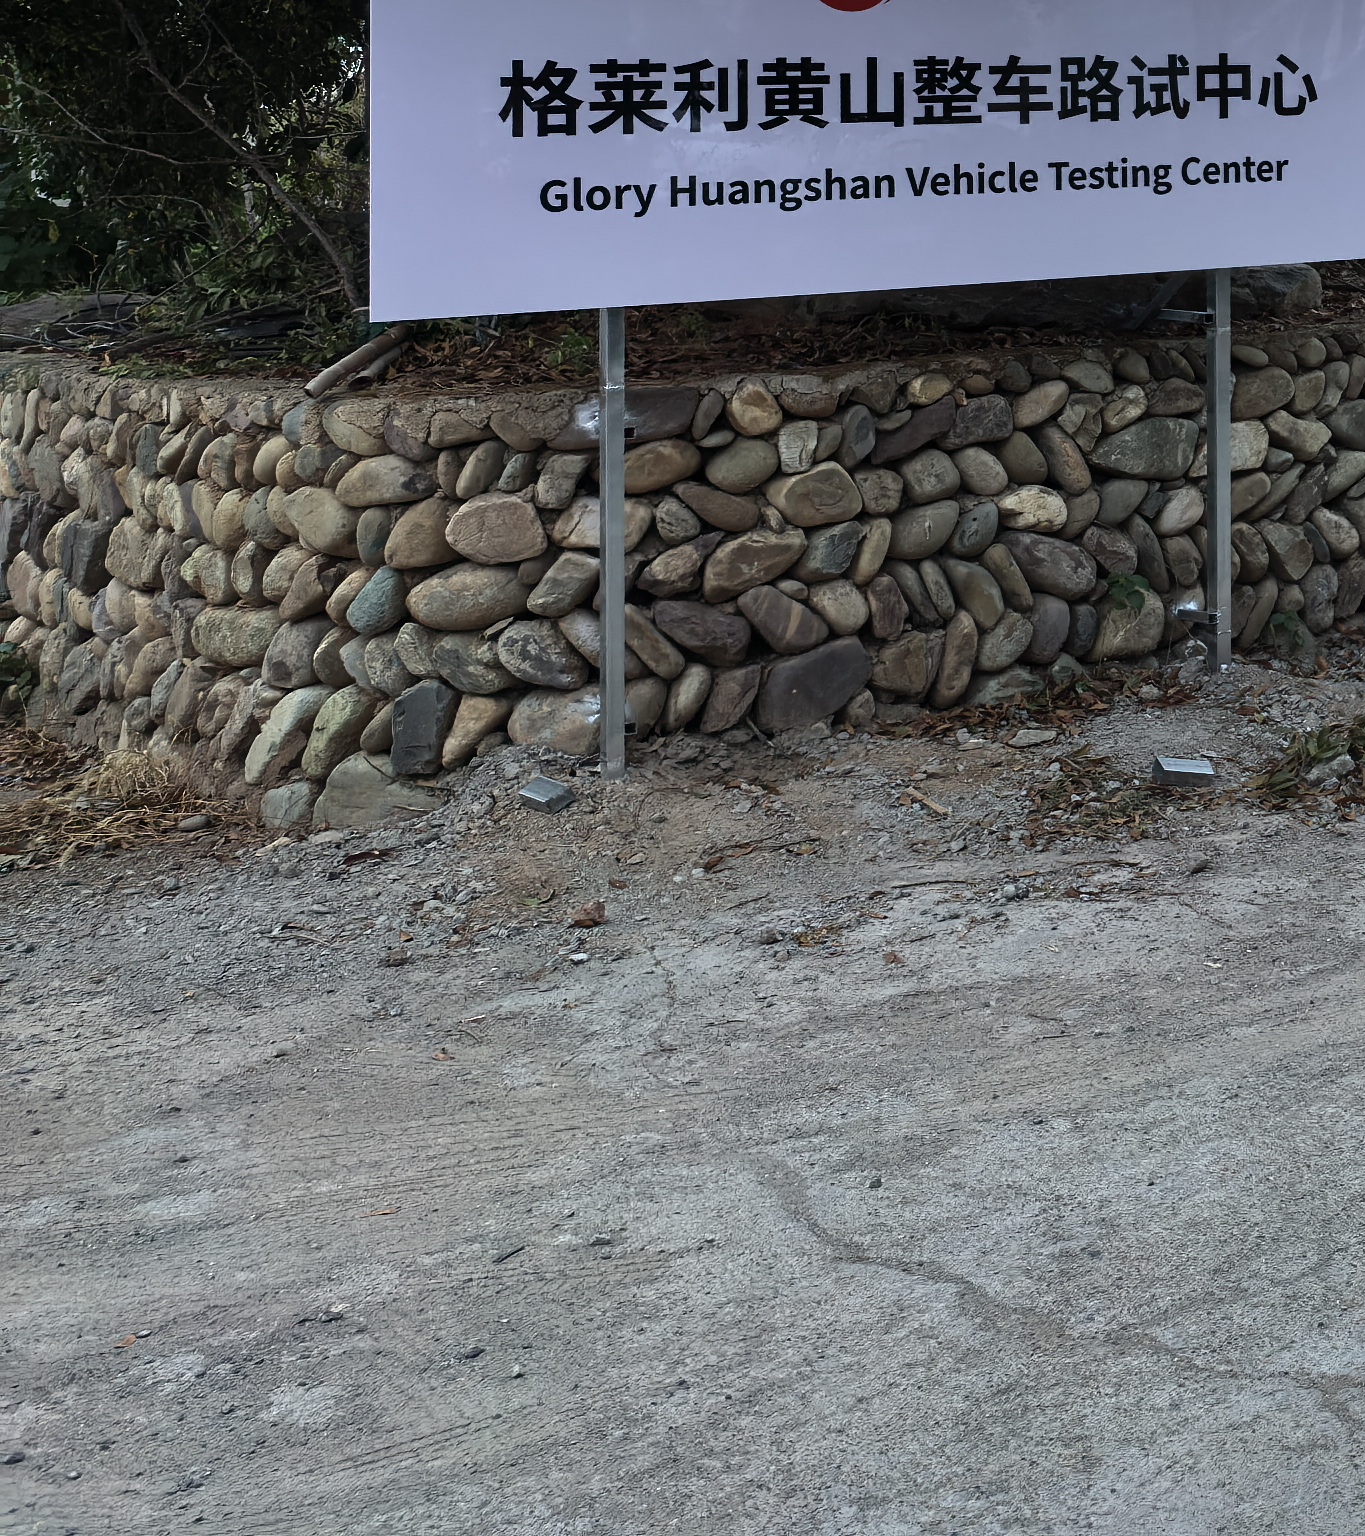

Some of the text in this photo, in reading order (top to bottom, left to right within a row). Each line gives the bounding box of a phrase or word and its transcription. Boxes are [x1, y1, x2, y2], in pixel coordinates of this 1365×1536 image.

[497, 52, 1320, 138] 格莱利黄山整车路试中心
[539, 156, 1290, 218] Glory Huangshan Vehicle Testing Center
